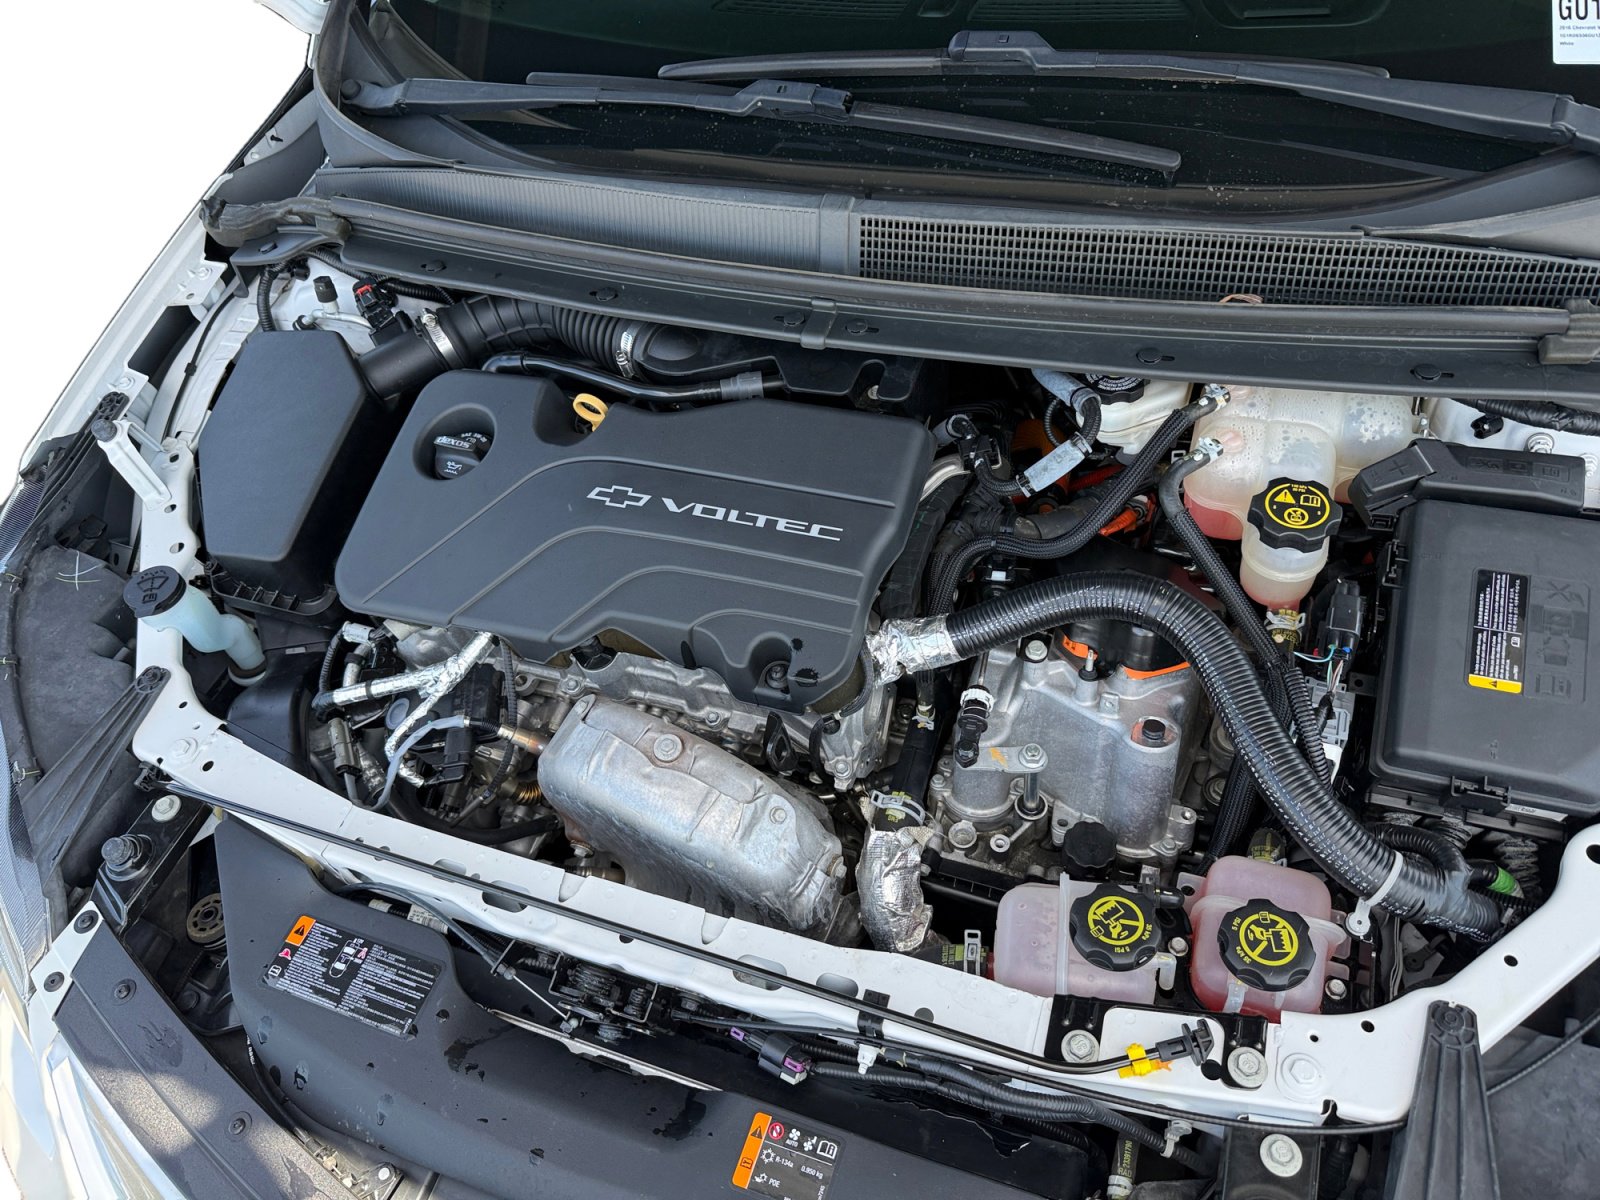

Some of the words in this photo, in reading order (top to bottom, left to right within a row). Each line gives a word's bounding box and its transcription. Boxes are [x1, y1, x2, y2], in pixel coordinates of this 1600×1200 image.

[436, 435, 470, 449] dexos
[661, 496, 844, 541] VOLTEC
[1232, 916, 1242, 927] PSI
[1146, 923, 1153, 931] 35
[1141, 931, 1151, 941] kPa
[1235, 946, 1246, 958] kPa
[1243, 955, 1252, 965] 35
[785, 1139, 799, 1148] AUTO
[775, 1156, 794, 1168] R-134a
[815, 1171, 824, 1180] kg
[768, 1178, 781, 1188] POE
